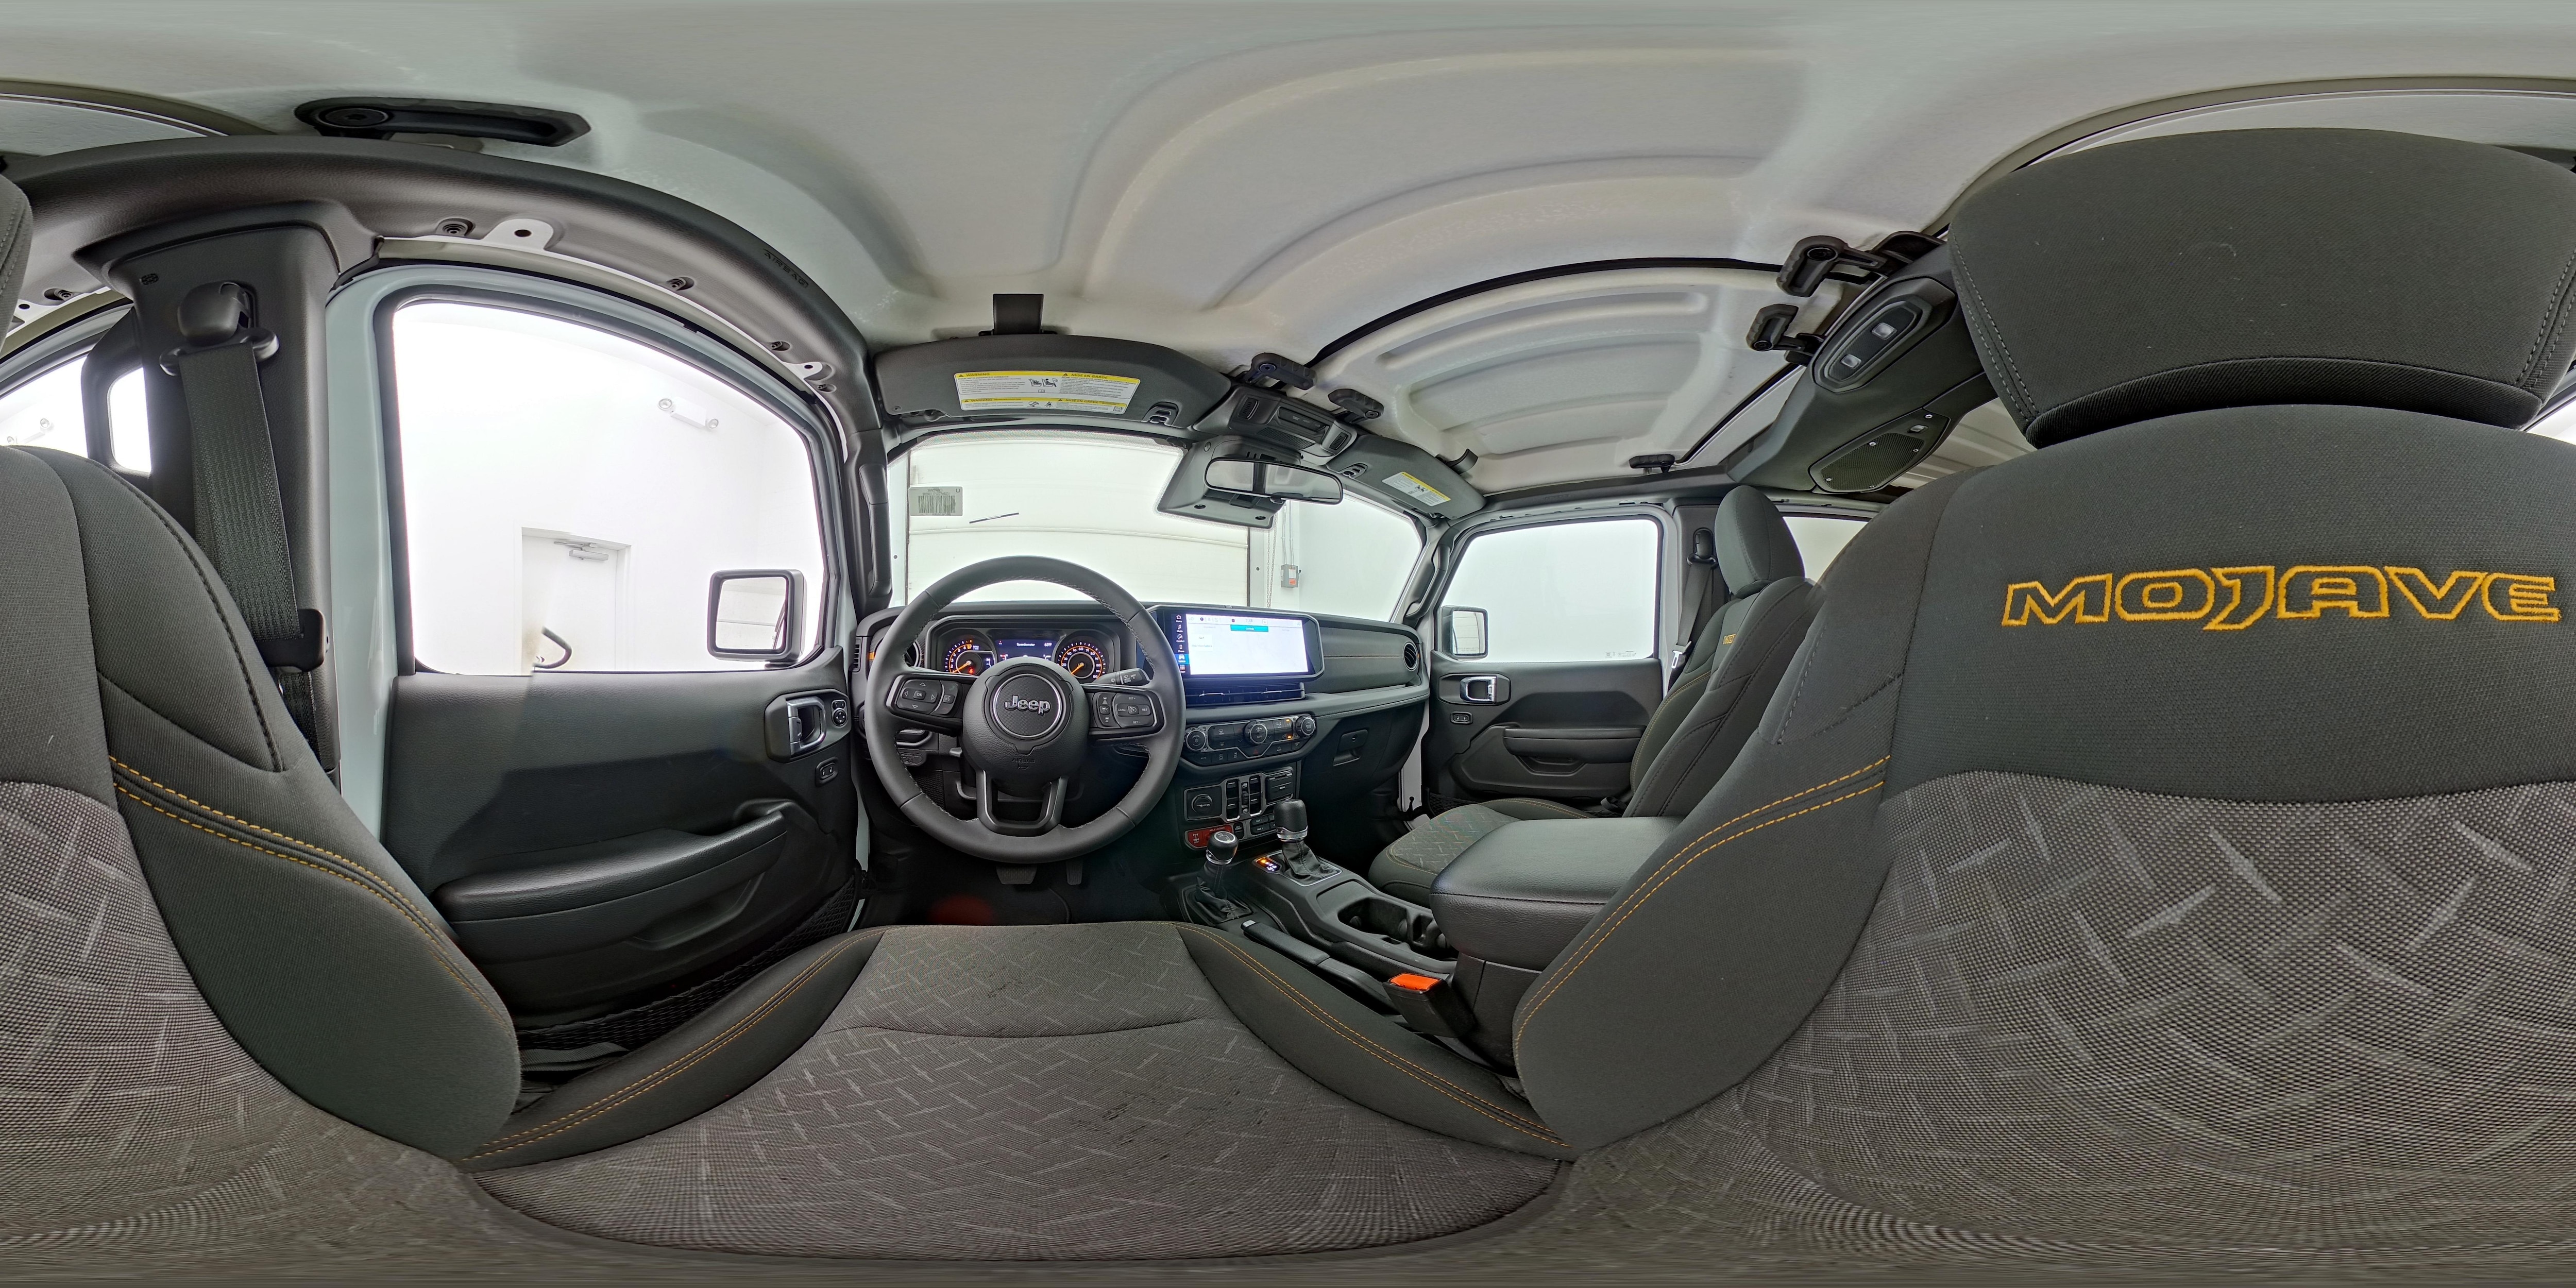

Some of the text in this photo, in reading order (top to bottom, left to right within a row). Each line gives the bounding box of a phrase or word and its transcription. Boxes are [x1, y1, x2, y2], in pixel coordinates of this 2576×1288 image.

[765, 252, 805, 285] AIRBAG
[2002, 565, 2561, 631] MOJAVE
[1005, 695, 1050, 715] Jeep
